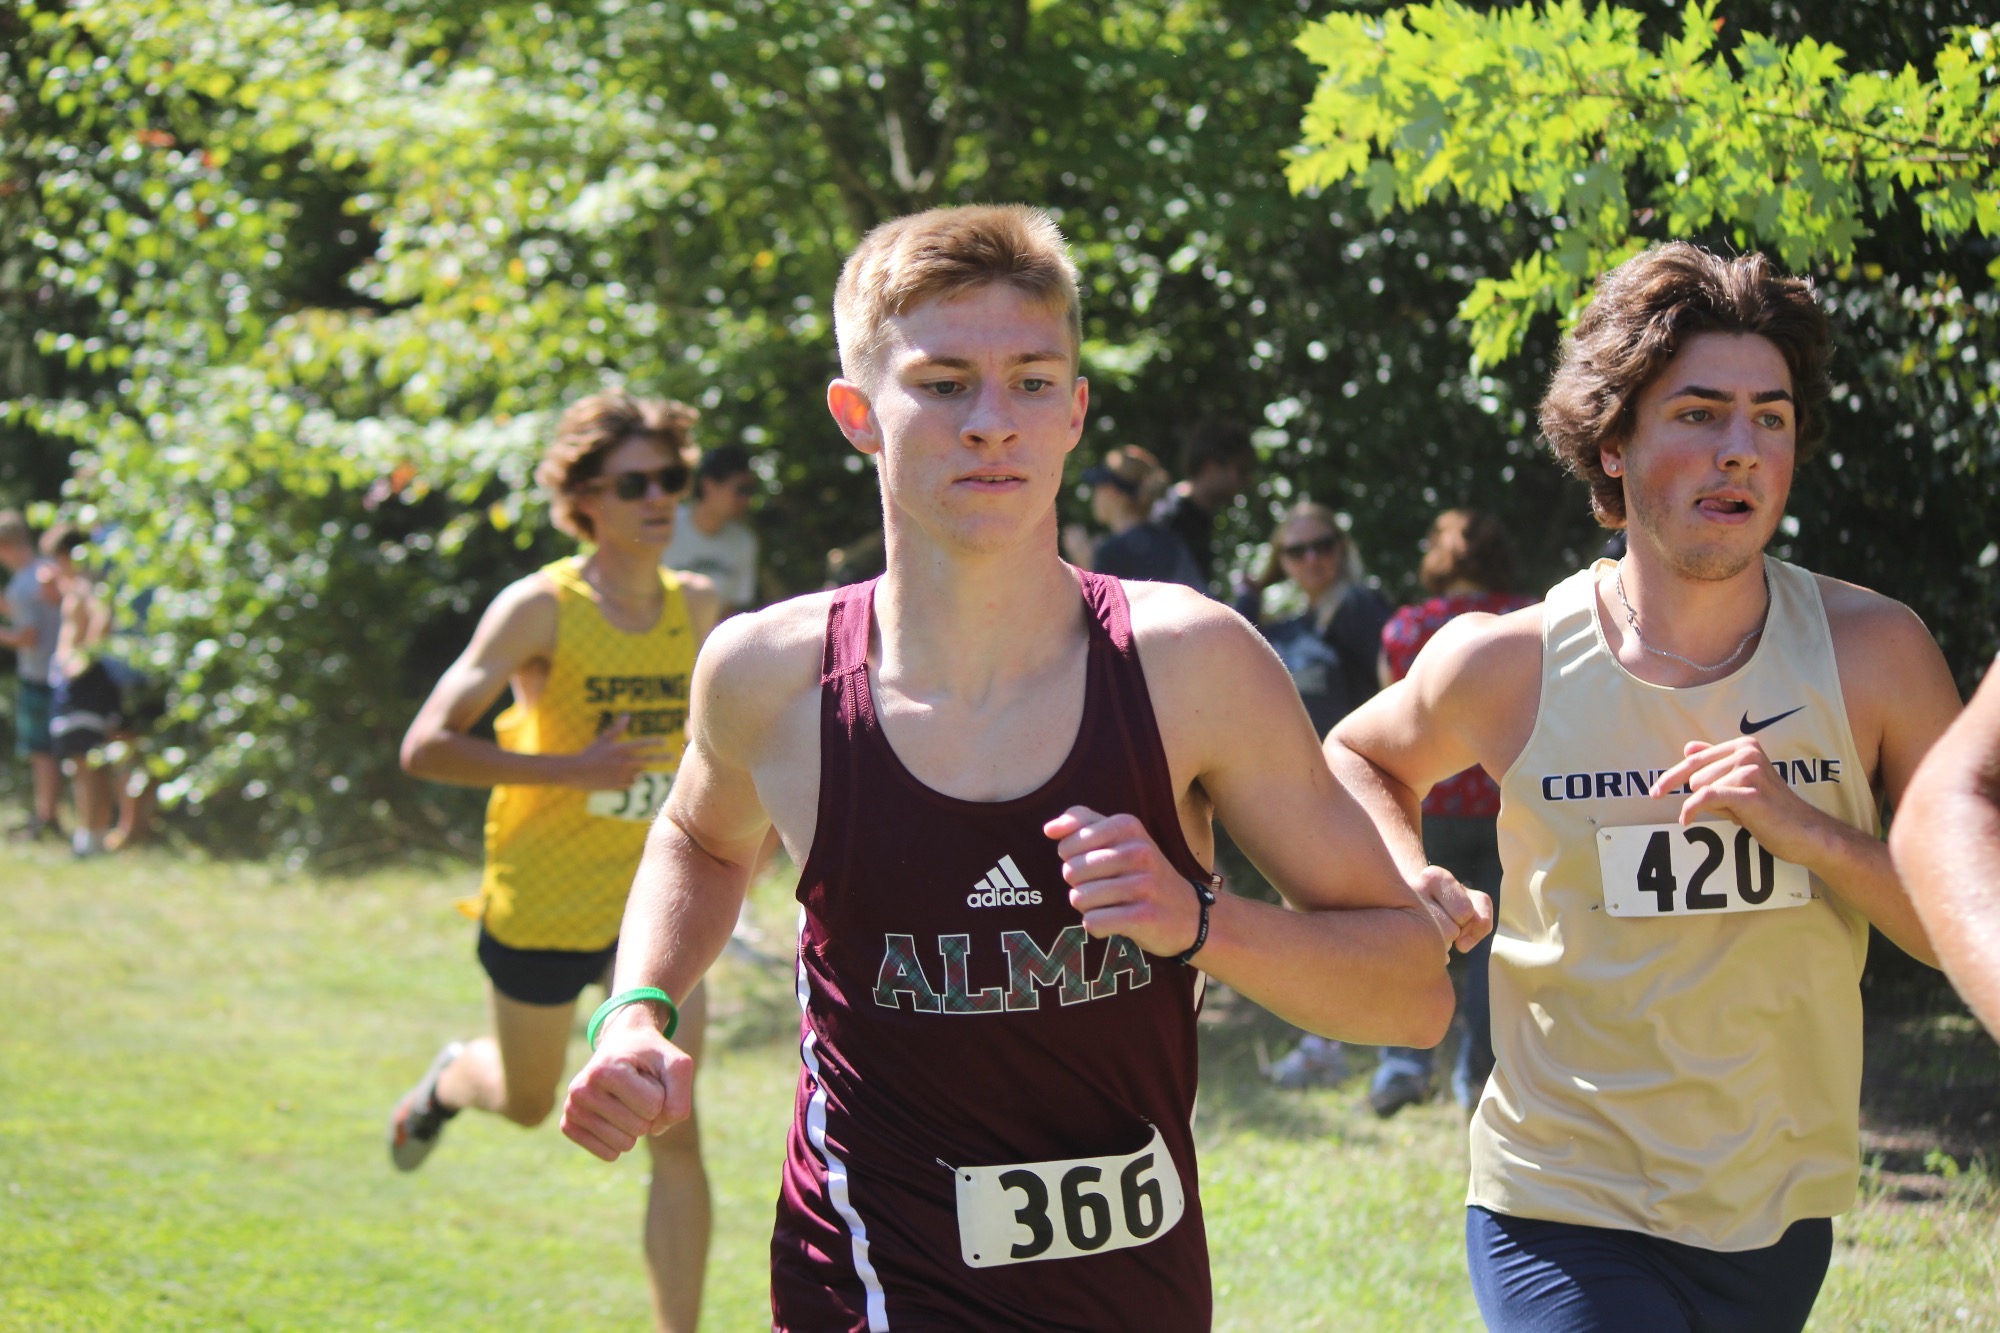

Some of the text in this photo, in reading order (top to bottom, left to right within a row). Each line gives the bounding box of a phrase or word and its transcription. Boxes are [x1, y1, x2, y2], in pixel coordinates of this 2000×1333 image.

[1541, 758, 1841, 801] CORNONE
[967, 887, 1043, 908] adidas
[1636, 826, 1775, 912] 420
[872, 925, 1151, 1014] ALMA
[998, 1152, 1164, 1259] 366
